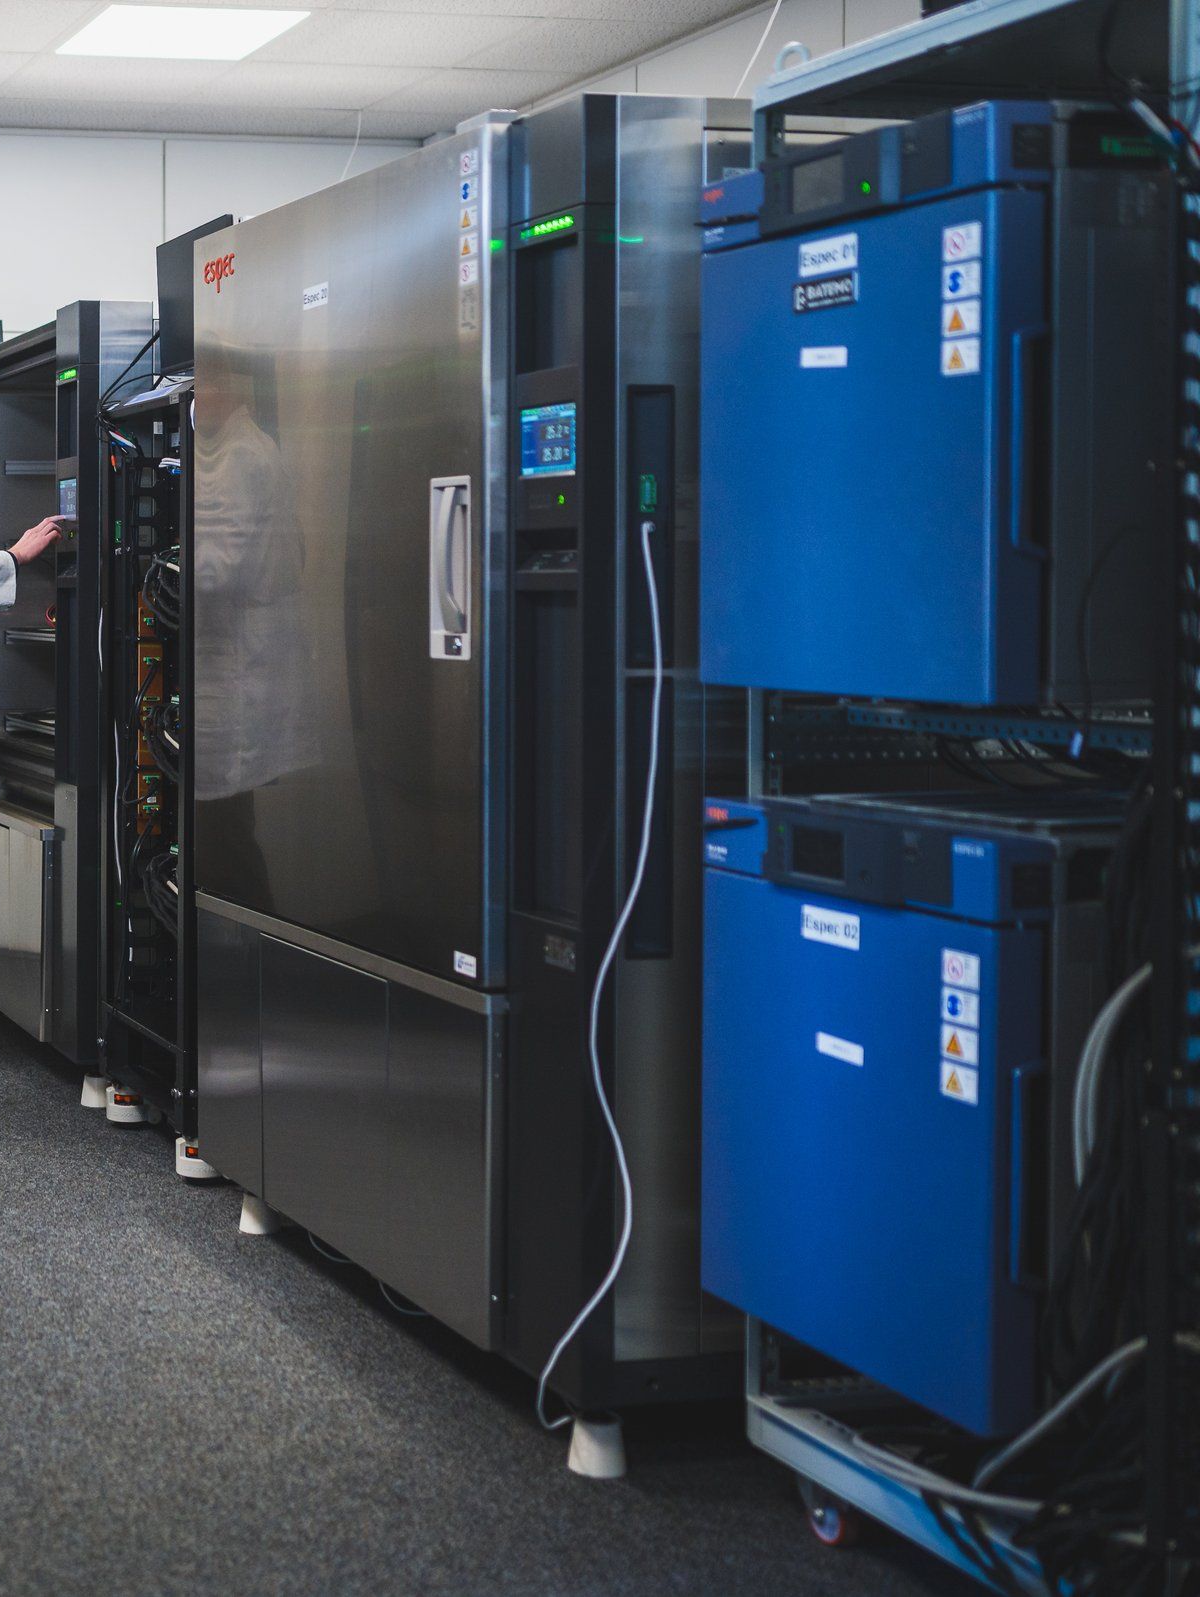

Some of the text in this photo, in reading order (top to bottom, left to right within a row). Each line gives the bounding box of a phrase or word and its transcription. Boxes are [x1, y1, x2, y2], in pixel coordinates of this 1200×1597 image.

[802, 249, 839, 268] Espec
[303, 292, 320, 305] Espec
[805, 914, 858, 941] Espec 02
